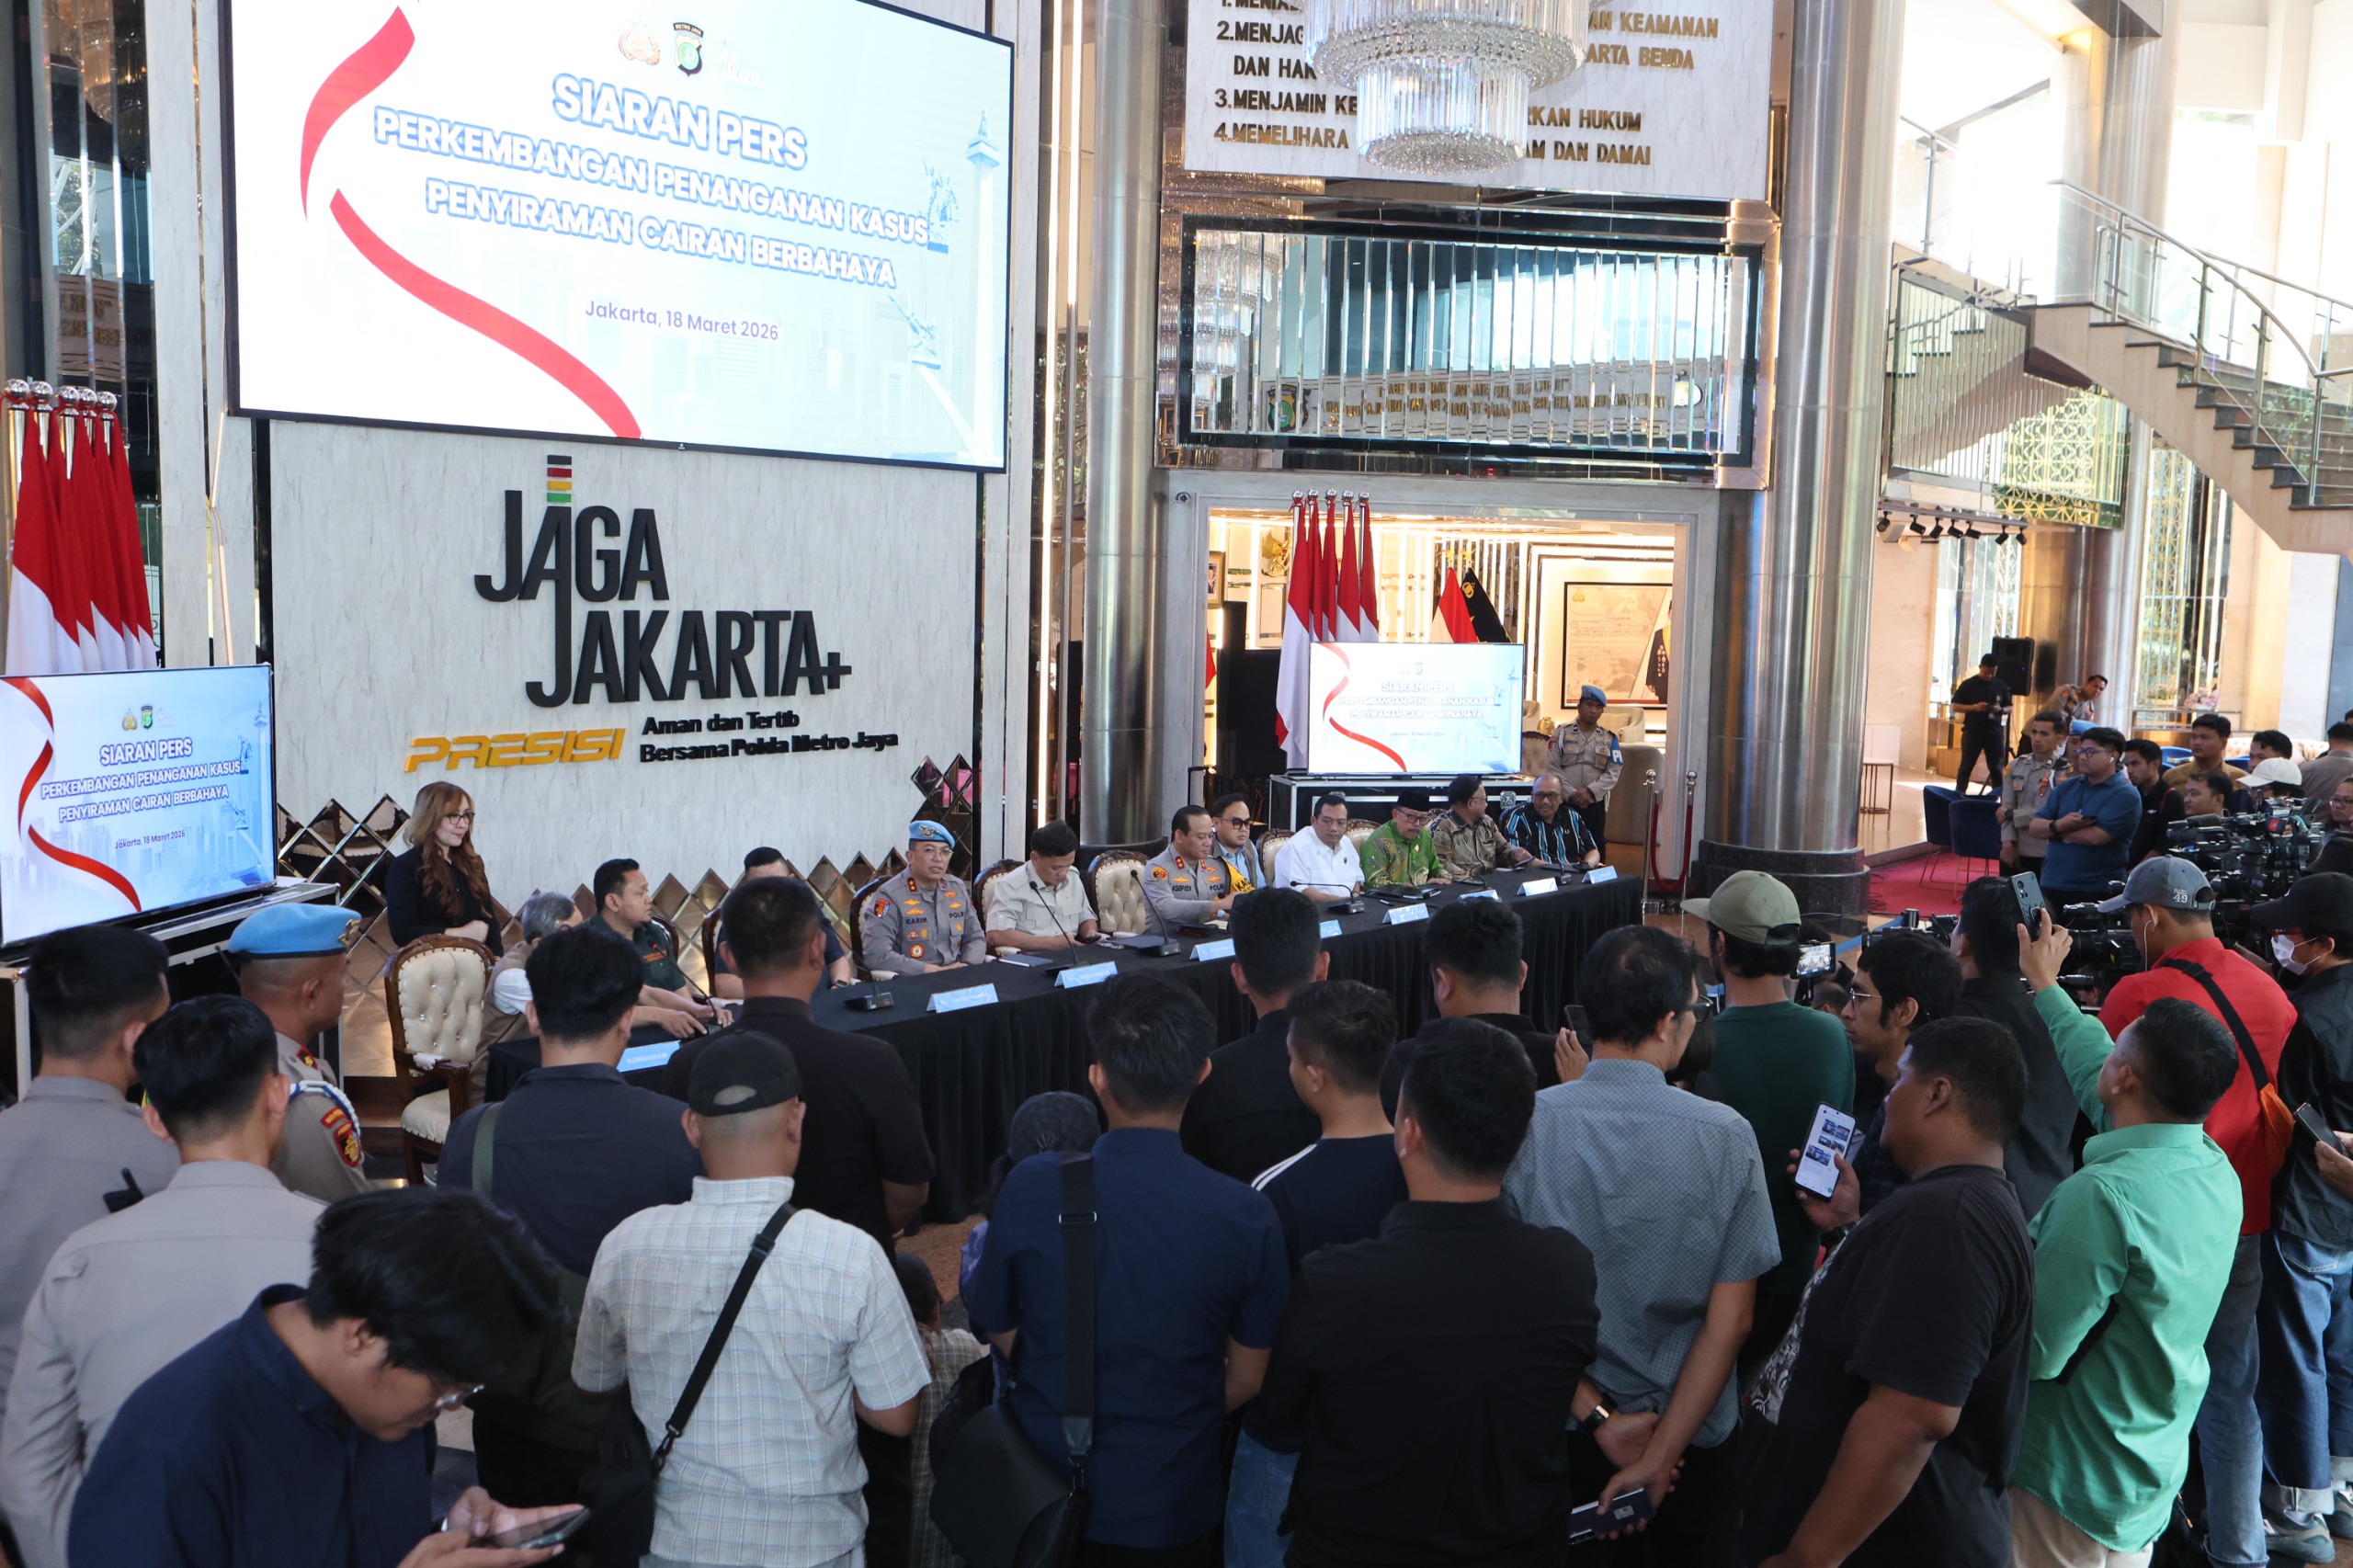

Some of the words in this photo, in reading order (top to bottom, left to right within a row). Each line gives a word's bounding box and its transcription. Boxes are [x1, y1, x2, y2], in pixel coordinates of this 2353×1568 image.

[1620, 12, 1719, 38] KEAMANAN
[1233, 55, 1270, 77] DAN
[1586, 43, 1630, 65] ARTA
[1639, 46, 1695, 70] BENDA
[552, 73, 710, 152] SIARAN
[717, 110, 807, 171] PERS
[1579, 108, 1642, 132] HUKUM
[1553, 141, 1588, 162] DAN
[1597, 142, 1652, 166] DAMAI
[374, 105, 648, 194] PERKEMBANGAN
[654, 162, 845, 231] PENANGANAN
[849, 201, 930, 246] KASUS
[426, 177, 633, 246] PENYIRAMAN
[638, 215, 746, 265] CAIRAN
[751, 235, 897, 290] BERBAHAYA
[585, 300, 662, 328] Jakarta,
[665, 310, 684, 328] 18
[688, 313, 737, 335] Maret
[740, 321, 779, 341] 2026
[474, 489, 670, 603] JAGA
[1381, 680, 1425, 693] SIARAN
[1426, 680, 1455, 693] PERS
[642, 716, 702, 736] Aman
[707, 713, 744, 732] dan
[746, 710, 801, 730] Tertib
[99, 739, 157, 767] SIARAN
[158, 737, 193, 760] PERS
[404, 728, 626, 773] PRESISI
[640, 742, 730, 763] Bersama
[731, 736, 790, 756] Polda
[791, 733, 850, 753] Metro
[851, 732, 900, 753] Jaya
[41, 772, 135, 800] PERKEMBANGAN
[137, 765, 208, 787] PENANGANAN
[210, 760, 242, 777] KASUS
[59, 797, 131, 823] PENYIRAMAN
[132, 791, 172, 812] CAIRAN
[173, 785, 230, 805] BERBAHAYA
[151, 832, 171, 844] Maret
[170, 829, 186, 840] 2026
[2173, 893, 2188, 903] 49
